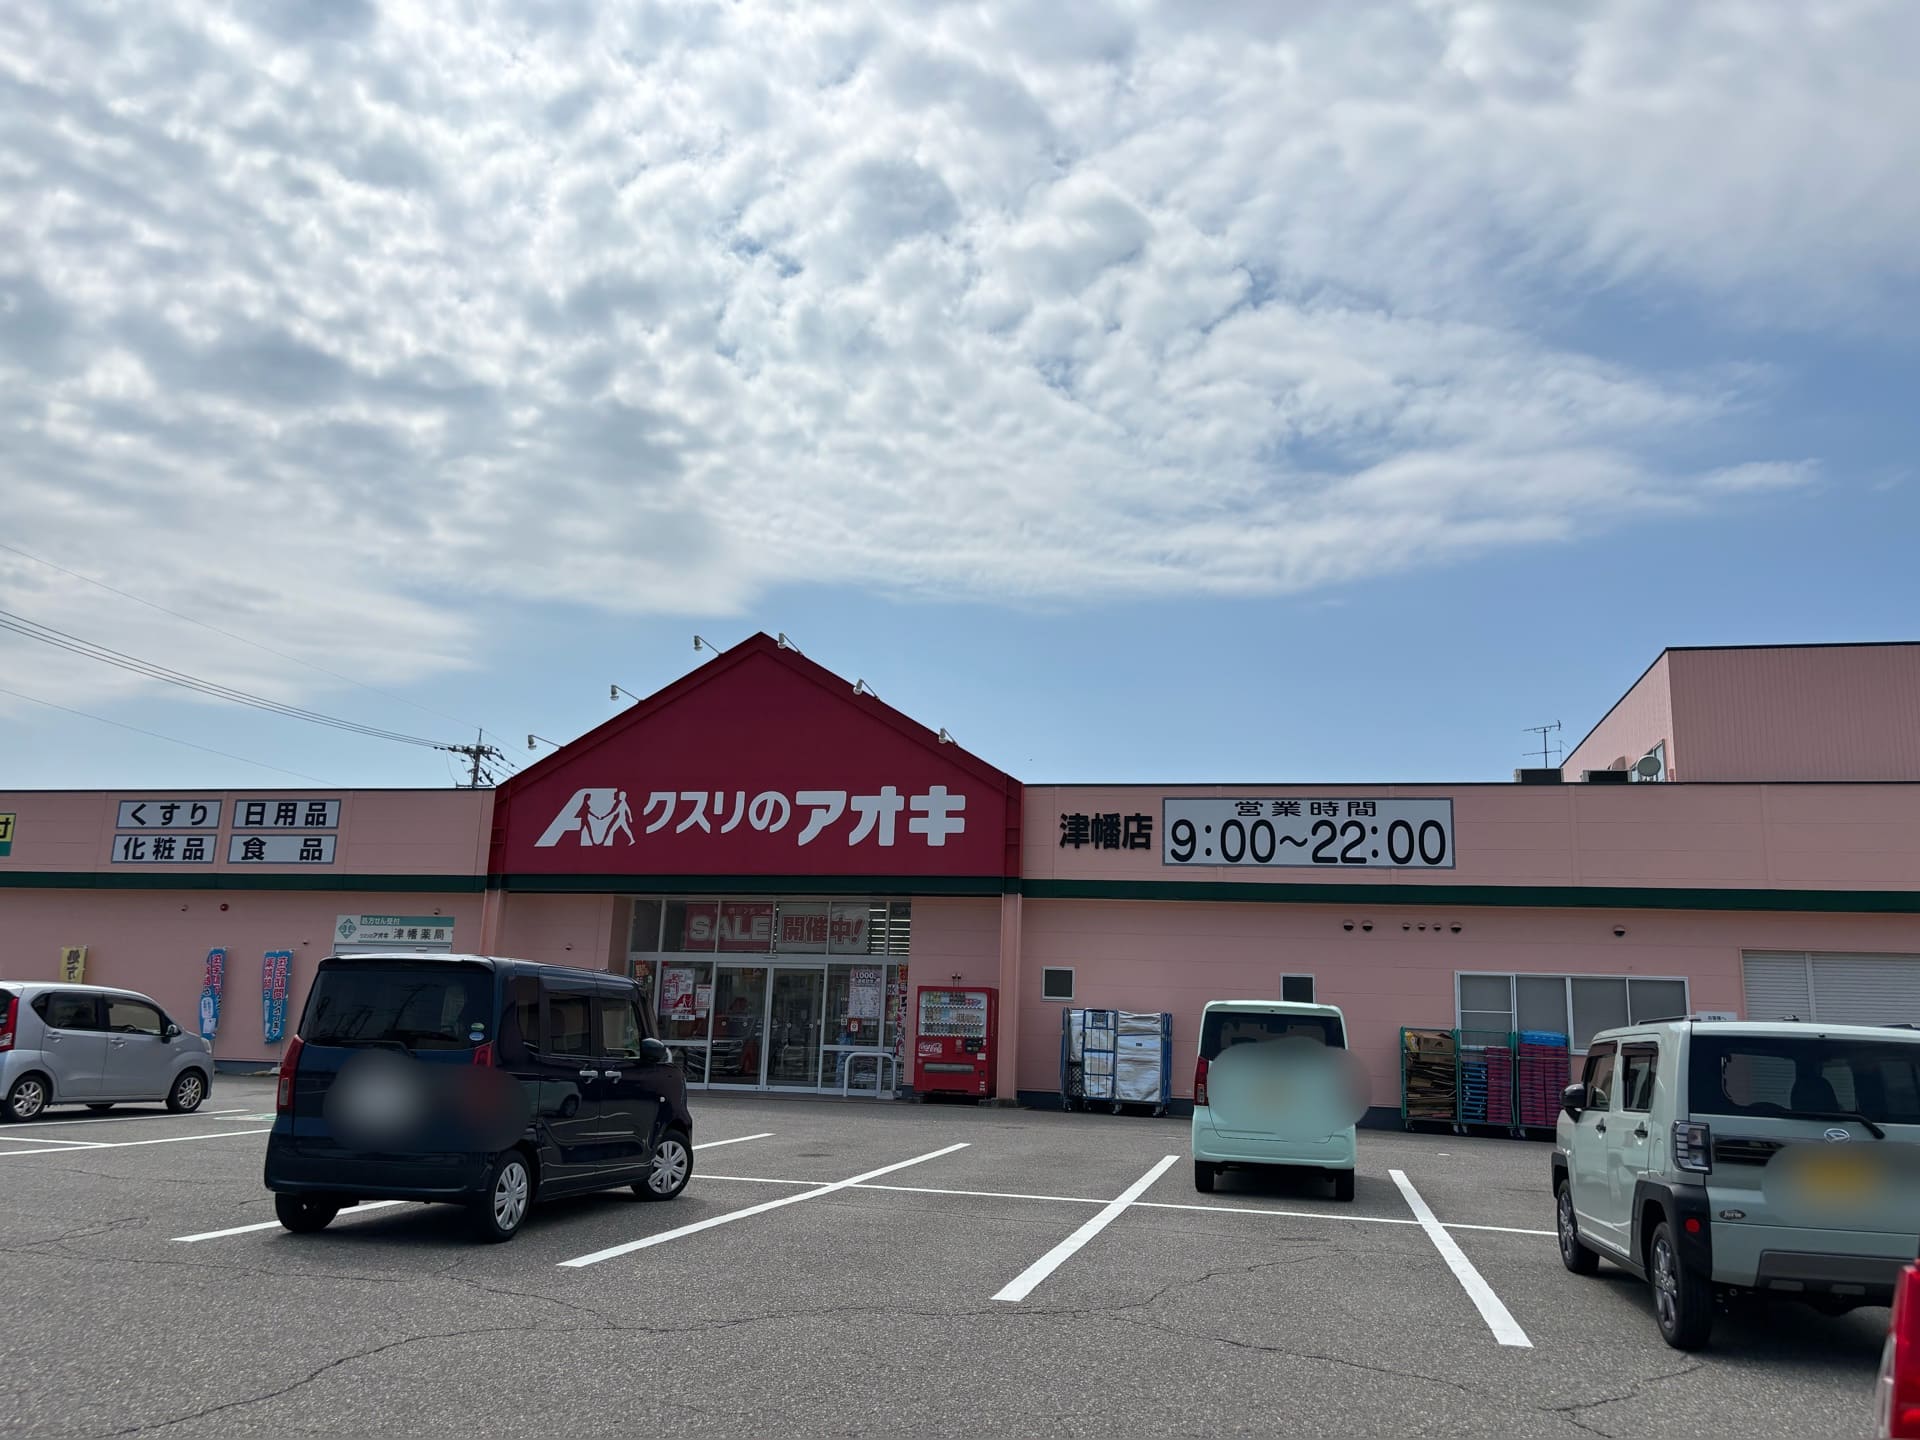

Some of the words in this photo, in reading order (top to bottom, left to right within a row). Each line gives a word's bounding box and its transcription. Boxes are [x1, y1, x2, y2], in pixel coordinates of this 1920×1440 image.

[131, 802, 208, 826] くすり
[245, 801, 328, 827] 日用品
[643, 785, 967, 847] クスリのアオキ
[1234, 800, 1377, 818] 営業時間
[1059, 813, 1154, 851] 津幡店
[123, 836, 206, 861] 化粧品
[240, 836, 324, 861] 食品
[393, 927, 445, 941] 津幡薬局
[690, 914, 772, 942] SALE
